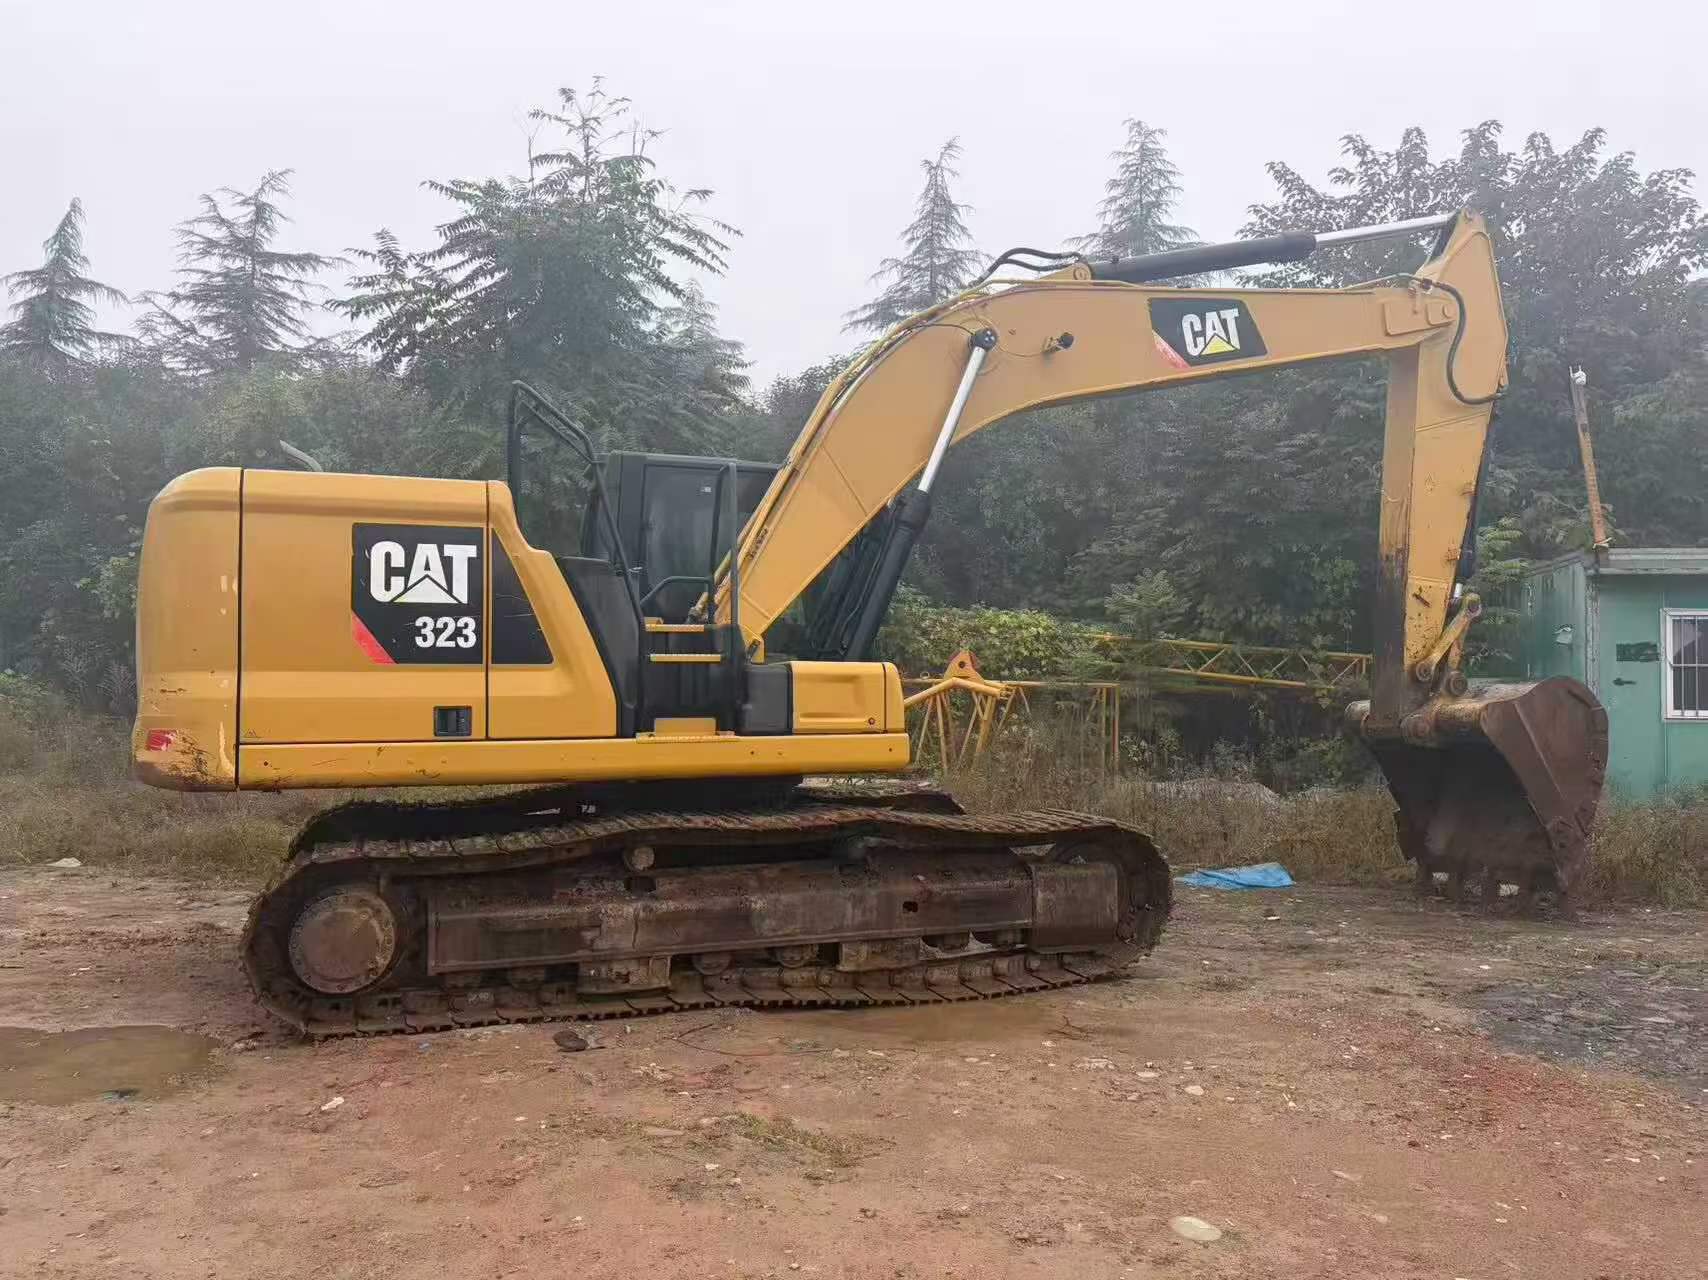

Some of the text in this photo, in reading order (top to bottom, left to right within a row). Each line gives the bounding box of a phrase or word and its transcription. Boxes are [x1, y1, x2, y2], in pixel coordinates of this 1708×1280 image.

[1181, 308, 1240, 356] CAT
[370, 541, 477, 604] CAT
[414, 616, 477, 648] 323
